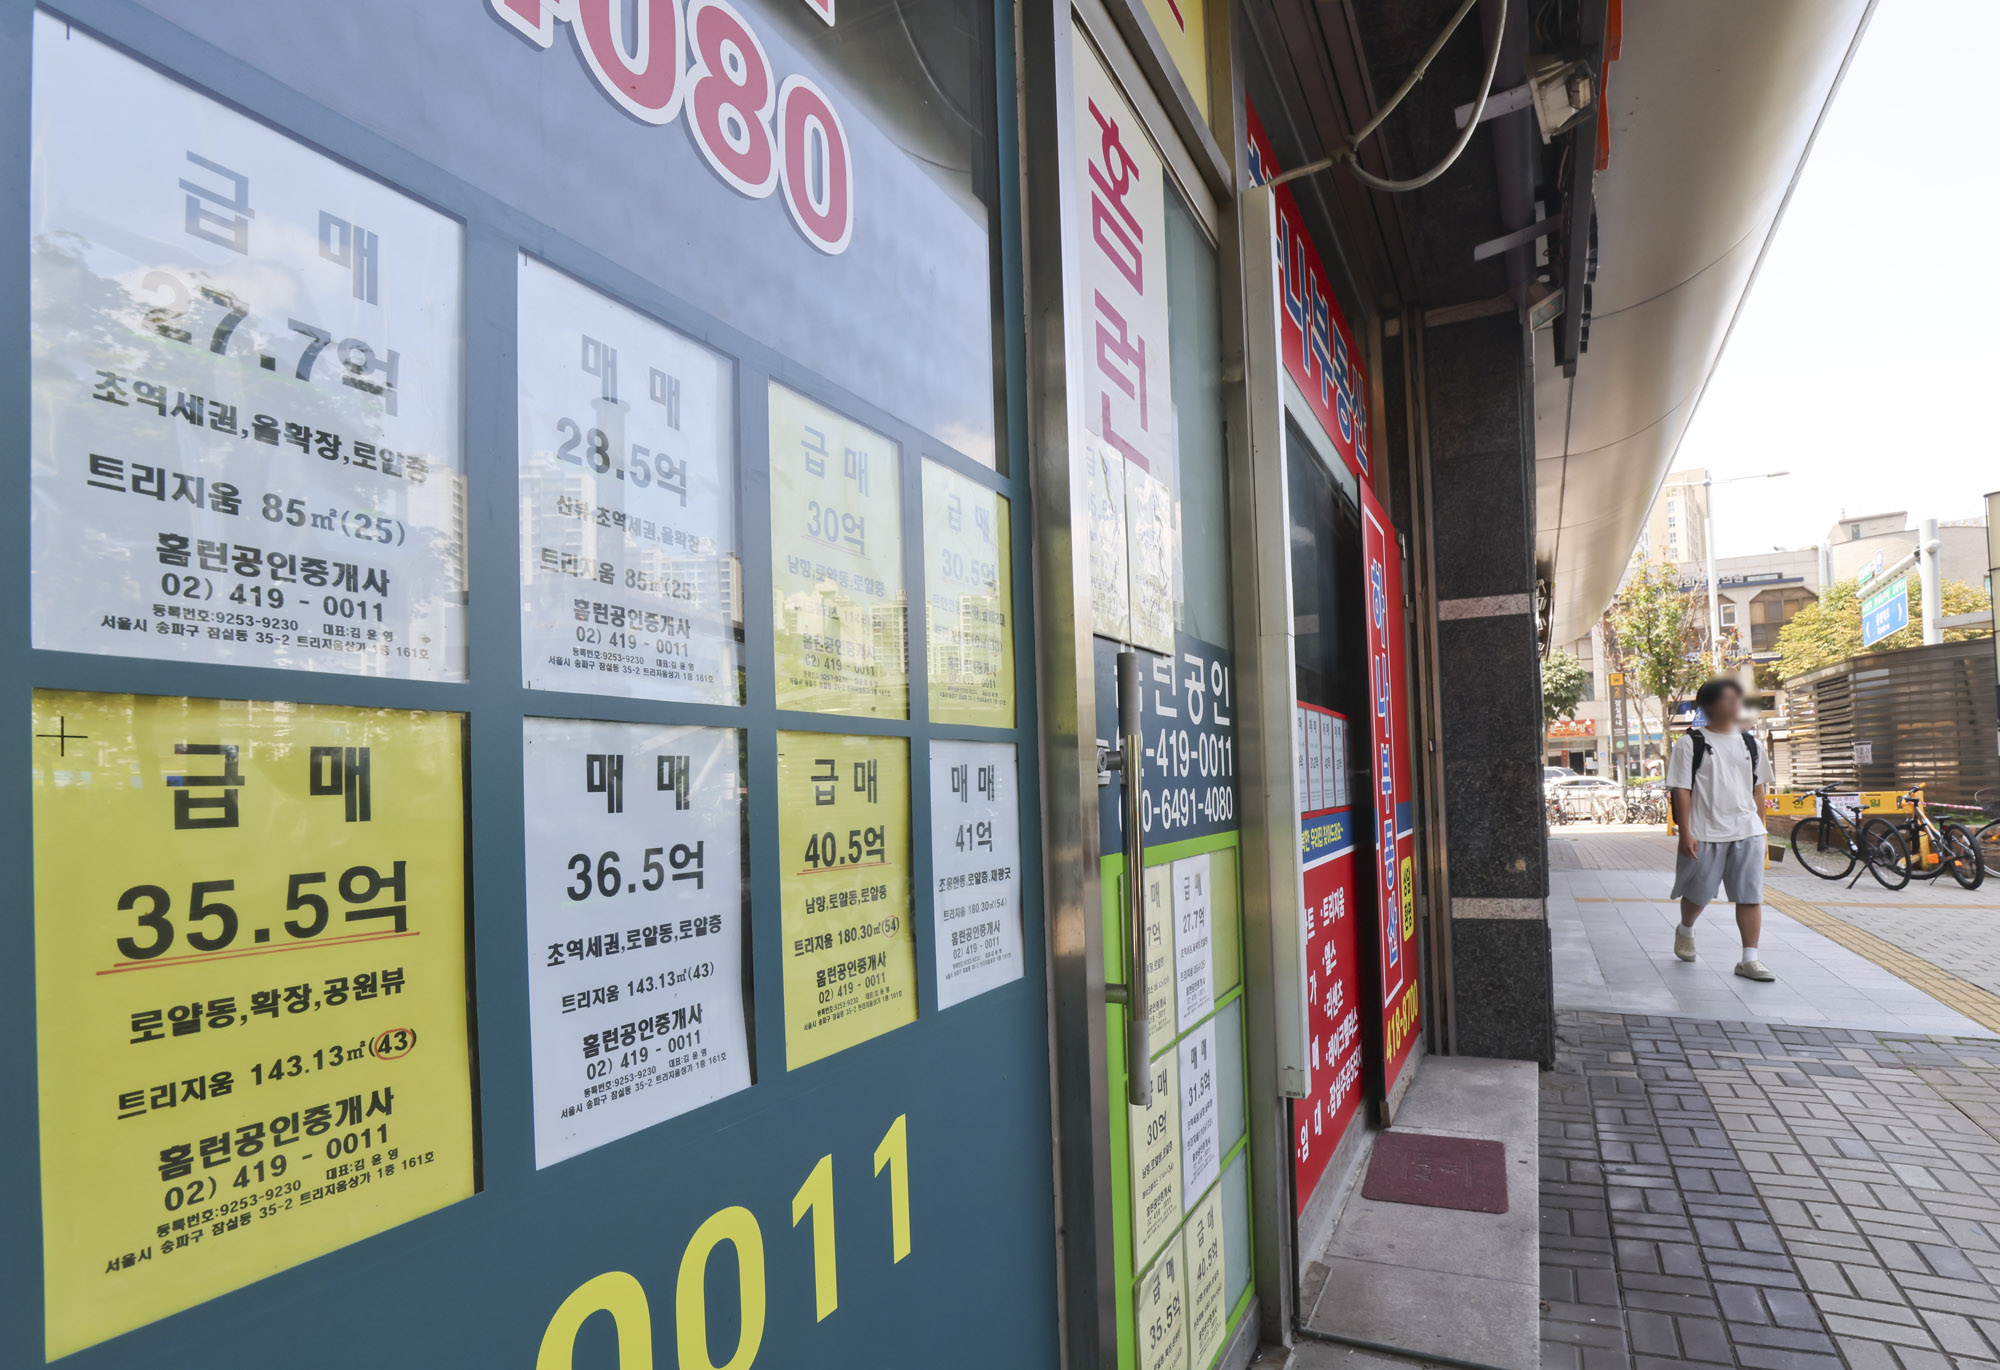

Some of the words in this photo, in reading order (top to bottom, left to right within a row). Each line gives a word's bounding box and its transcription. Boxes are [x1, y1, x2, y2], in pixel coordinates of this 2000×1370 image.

[491, 0, 854, 255] 080
[179, 149, 255, 256] 급
[318, 209, 378, 305] 매
[141, 270, 400, 416] 27.7억
[582, 334, 618, 404] 매
[650, 366, 680, 431] 매
[87, 453, 242, 516] 트리지움
[557, 417, 687, 508] 28.5억
[801, 425, 829, 479] 급
[844, 447, 870, 497] 매
[807, 500, 865, 556] 30억
[156, 532, 390, 598] 홈런공인중개사
[540, 547, 615, 585] 트리지움
[161, 572, 214, 601] 02)
[229, 583, 284, 609] 419
[323, 595, 383, 622] 0011
[573, 598, 690, 639] 홈런공인중개사
[101, 614, 147, 632] 서울시
[156, 621, 200, 638] 송파구
[208, 626, 248, 643] 잠실동
[255, 632, 290, 646] 35-2
[576, 626, 602, 644] 02)
[609, 631, 637, 650] 419
[656, 638, 689, 658] 0011
[548, 656, 571, 667] 서울시
[574, 659, 595, 670] 송파구
[622, 665, 640, 675] 35-2
[824, 657, 842, 671] 419
[1114, 653, 1230, 726] 런공인
[1116, 726, 1233, 778] -419-0011
[1371, 557, 1398, 968] 하나부동산
[167, 744, 245, 829] 급
[310, 747, 371, 822] 매
[586, 754, 624, 814] 매
[657, 755, 690, 810] 매
[811, 759, 839, 806] 급
[854, 759, 877, 804] 매
[951, 764, 968, 803] 매
[978, 764, 995, 802] 매
[1118, 785, 1233, 833] 0-6491-4080
[804, 825, 884, 868] 40.5억
[956, 821, 992, 852] 41억
[567, 840, 704, 901] 36.5억
[116, 861, 407, 960] 35.5억
[805, 885, 887, 914] 남향,로얄동,로얄층
[943, 906, 966, 921] 트리지움
[1183, 906, 1205, 934] 27.7억
[1322, 886, 1345, 927] 트리지움
[547, 914, 722, 967] 초역세권,로얄동,로얄층
[794, 933, 833, 957] 트리지움
[951, 920, 1001, 946] 홈런공인중개사
[966, 943, 977, 956] 419
[984, 937, 1000, 950] 0011
[1324, 939, 1336, 976] 엘스
[816, 951, 887, 988] 홈런공인중개사
[818, 989, 834, 1004] 02)
[837, 982, 854, 998] 419
[865, 972, 886, 988] 0011
[130, 967, 405, 1044] 로얄동,확장,공원뷰
[562, 984, 619, 1014] 트리지움
[1326, 978, 1344, 1020] 리센츠
[1386, 978, 1419, 1065] 418-8700
[582, 1002, 703, 1059] 홈런공인중개사
[586, 1057, 613, 1080] 02)
[620, 1046, 648, 1069] 419
[668, 1029, 701, 1053] 0011
[117, 1071, 234, 1120] 트리지움
[560, 1102, 583, 1119] 서울시
[586, 1094, 608, 1110] 송파구
[611, 1085, 632, 1101] 잠실동
[635, 1078, 653, 1092] 35-2
[655, 1064, 693, 1085] 트리지움상가
[708, 1052, 727, 1065] 161호
[1188, 1069, 1210, 1107] 31.5억
[158, 1086, 394, 1181] 홈런공인중개사
[1147, 1110, 1167, 1146] 30억
[164, 1176, 217, 1211] 02)
[233, 1154, 287, 1189] 419
[326, 1123, 388, 1160] 0011
[105, 1246, 152, 1274] 서울시
[160, 1229, 204, 1254] 송파구
[212, 1212, 252, 1237] 잠실동
[259, 1198, 293, 1220] 35-2
[299, 1173, 371, 1206] 트리지움상가
[401, 1151, 435, 1170] 161호
[156, 1179, 301, 1238] 등록번호:9253-9230
[1197, 1237, 1218, 1281] 40.5억
[1150, 1290, 1180, 1350] 35.5억
